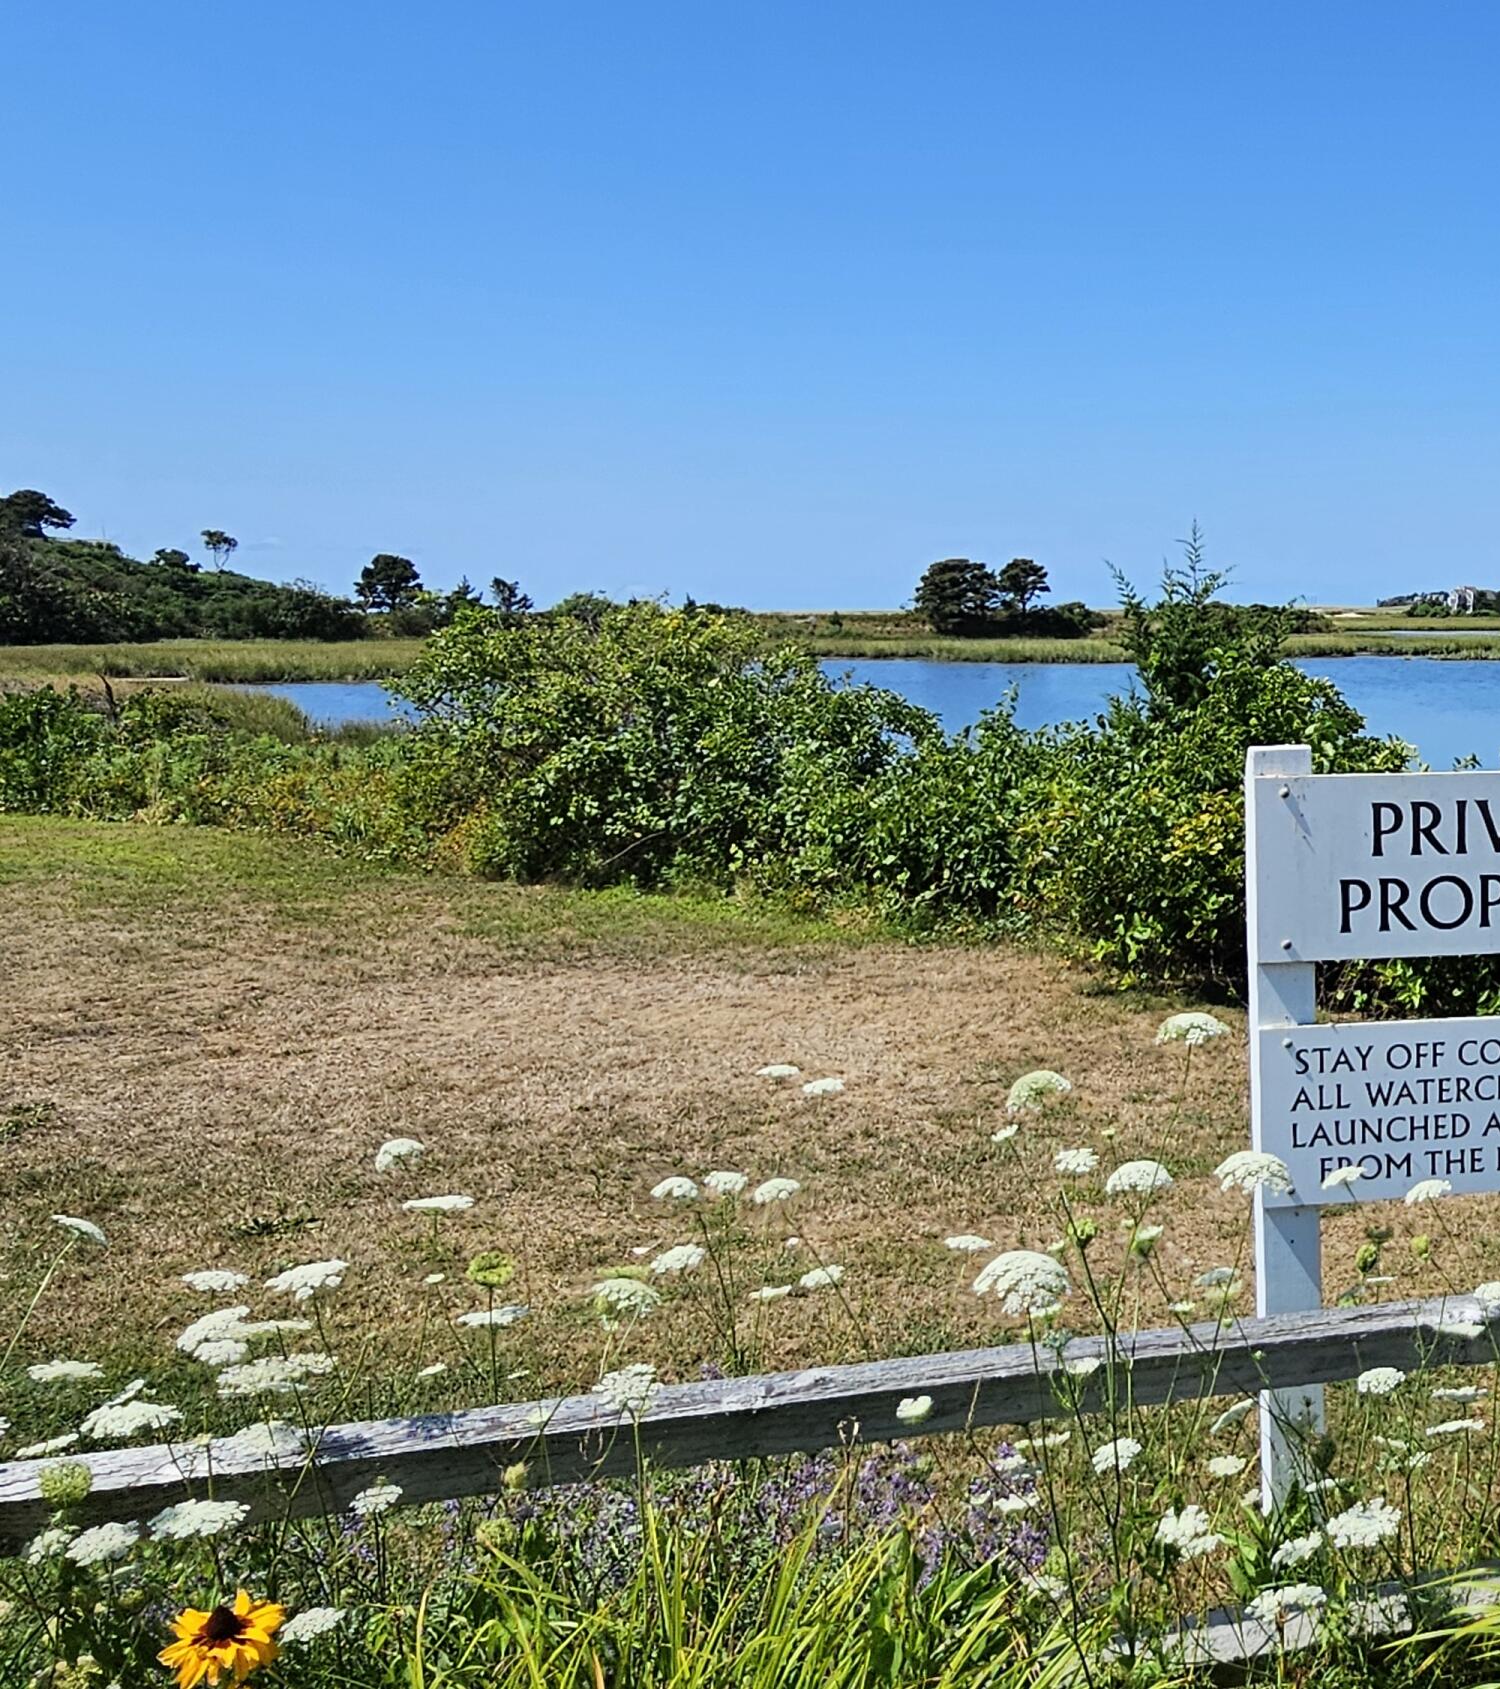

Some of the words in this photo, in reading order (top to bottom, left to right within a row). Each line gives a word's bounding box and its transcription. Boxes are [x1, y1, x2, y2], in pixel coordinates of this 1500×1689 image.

[1295, 1045, 1374, 1075] STAY
[1386, 1041, 1446, 1070] OFF
[1290, 1083, 1351, 1112] ALL
[1292, 1113, 1471, 1149] LAUNCHED
[1423, 1147, 1485, 1176] THE
